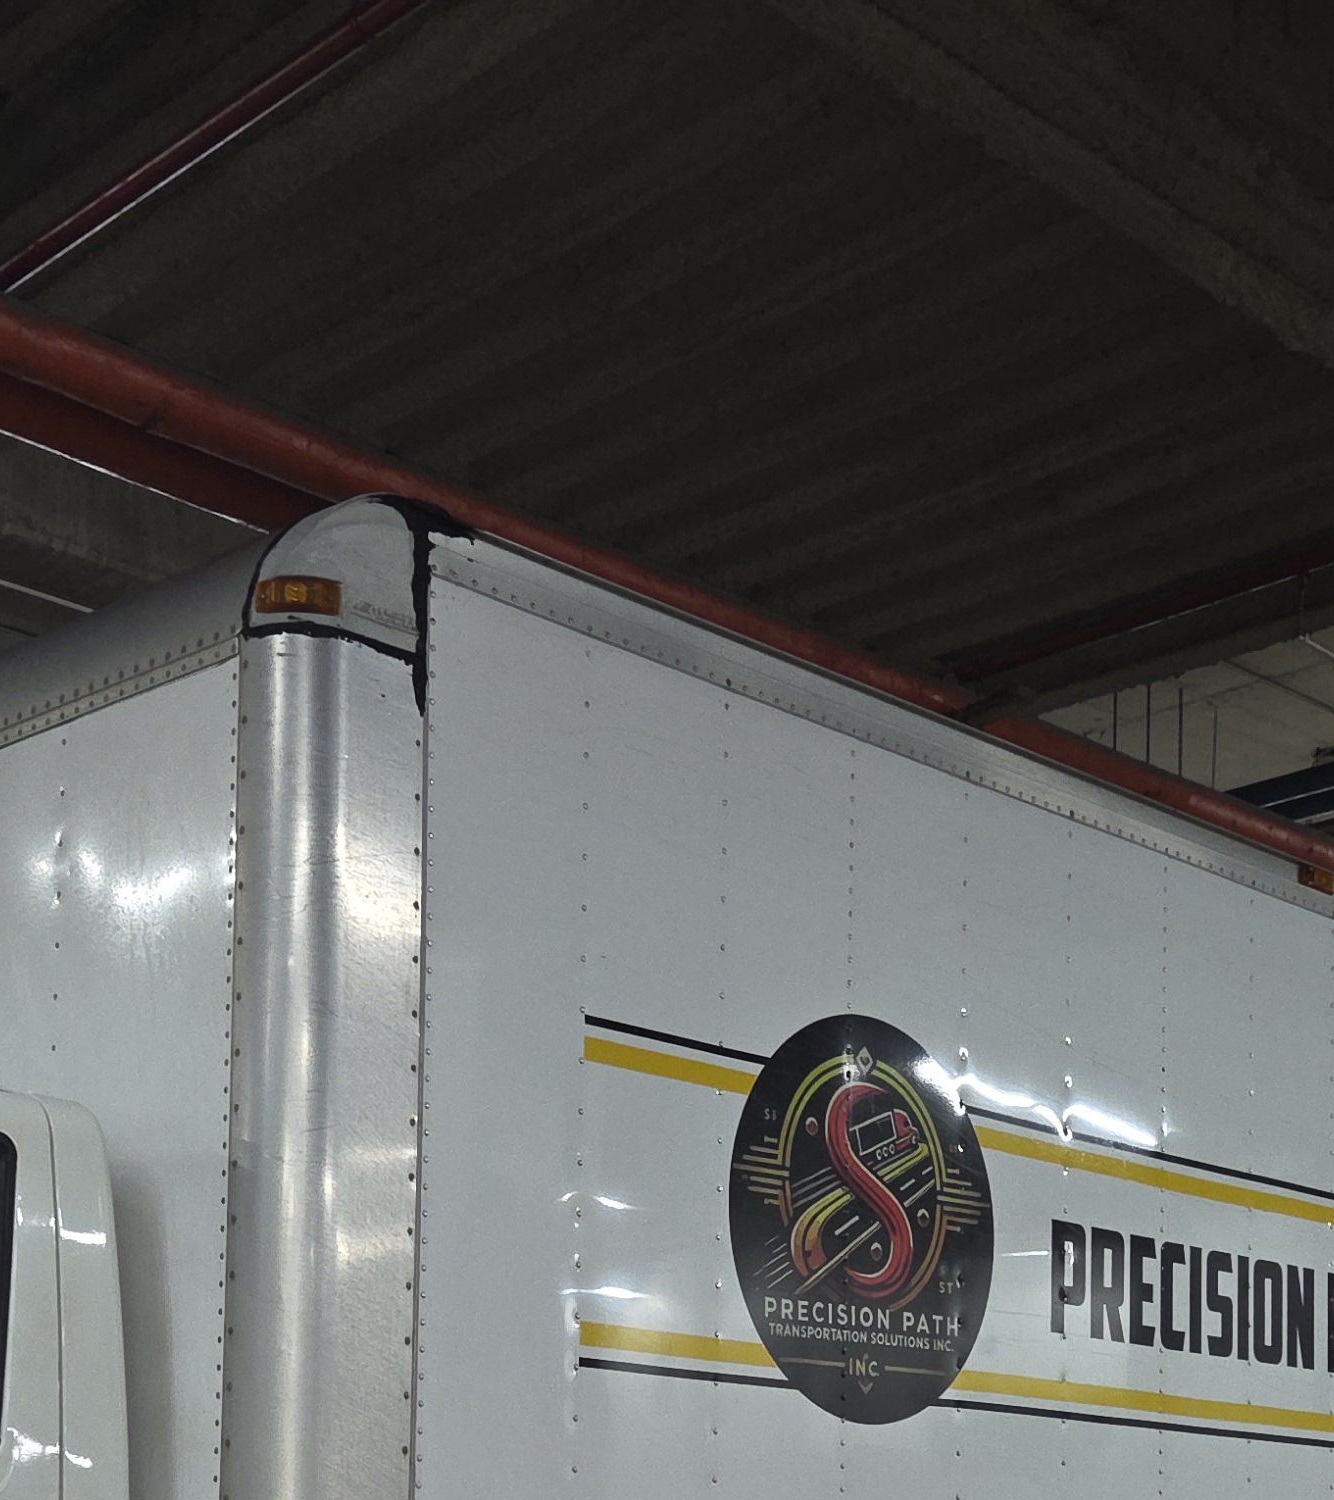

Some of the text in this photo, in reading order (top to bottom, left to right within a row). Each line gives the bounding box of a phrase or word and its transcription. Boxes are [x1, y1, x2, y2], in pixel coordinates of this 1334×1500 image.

[1050, 1219, 1315, 1370] PRECISION
[764, 1296, 959, 1338] PRECISION PATH
[769, 1322, 955, 1352] TRANSPORTATION SOLUTIONS INC.
